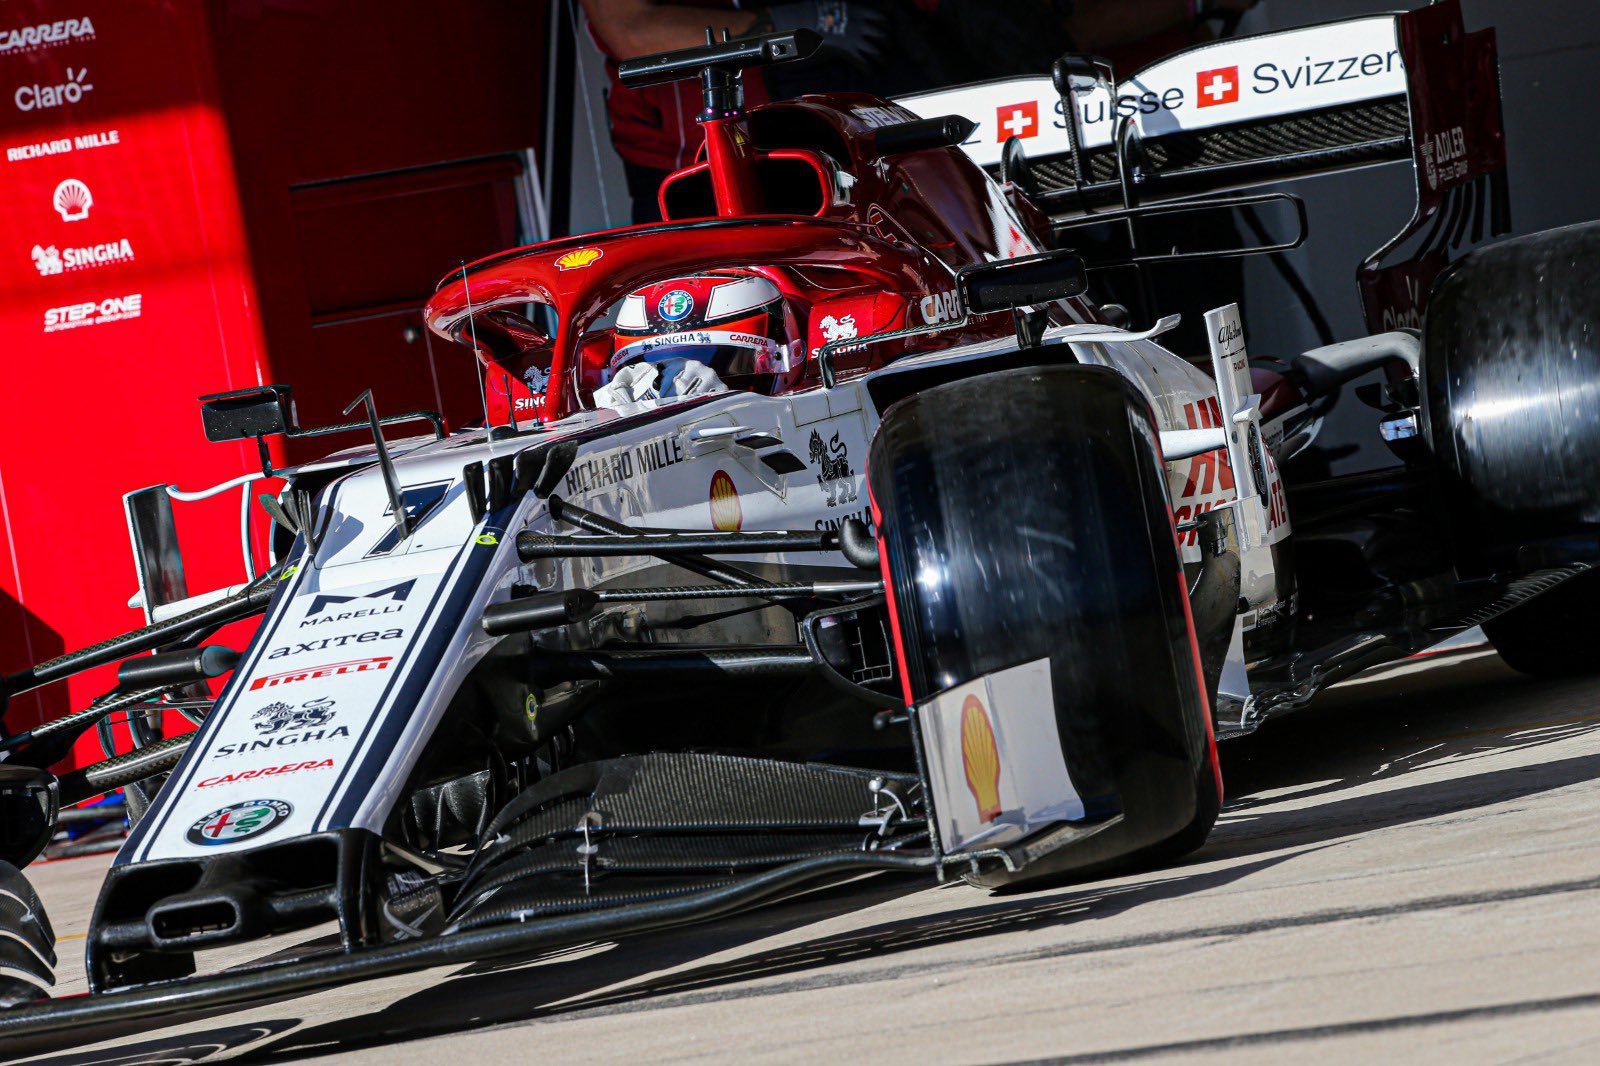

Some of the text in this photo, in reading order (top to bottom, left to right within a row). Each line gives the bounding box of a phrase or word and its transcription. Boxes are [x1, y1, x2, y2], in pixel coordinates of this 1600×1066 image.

[0, 16, 95, 50] CARRERA
[1252, 48, 1405, 95] Svizzer
[15, 81, 84, 111] Claro
[7, 130, 120, 161] RICHARD MILLE
[1435, 126, 1466, 164] ADLER
[63, 238, 134, 268] SINGHA
[654, 332, 695, 347] SINGHA
[729, 334, 769, 348] CARRERA
[565, 437, 683, 496] RICHARD MILLE
[299, 604, 404, 629] MARELLI
[248, 656, 394, 692] PIRELLI
[213, 725, 350, 759] SINGHA
[197, 758, 335, 788] CARRERA
[241, 799, 289, 818] ROMEO
